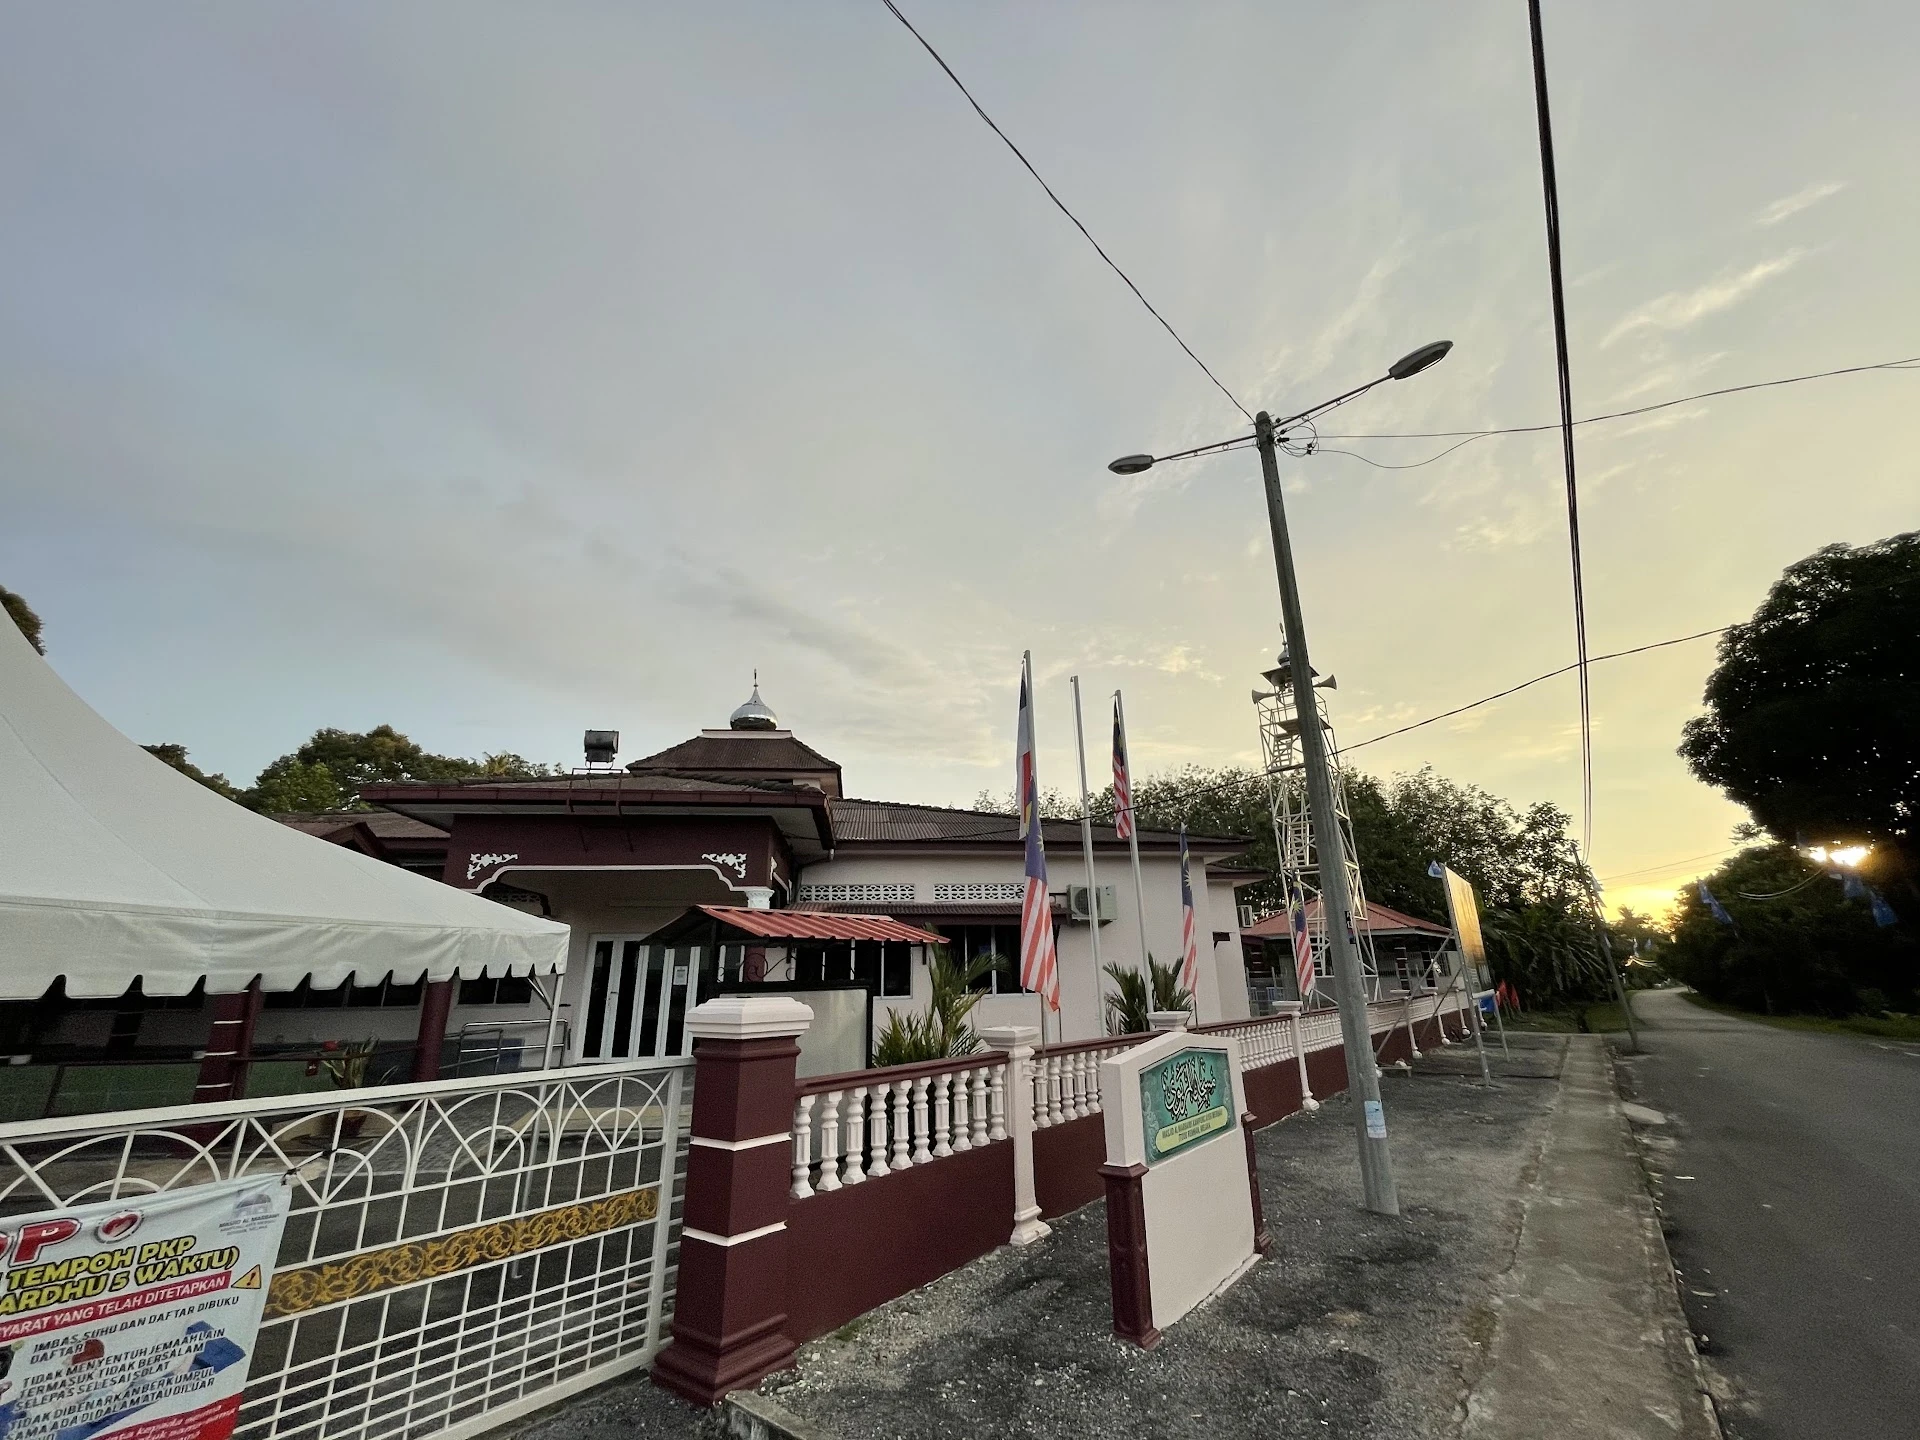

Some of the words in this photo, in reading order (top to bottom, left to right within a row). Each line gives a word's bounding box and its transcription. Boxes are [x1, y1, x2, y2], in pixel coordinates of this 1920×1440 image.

[0, 1217, 82, 1268] P
[6, 1246, 137, 1292] TEMPOH
[137, 1235, 197, 1265] PKP
[108, 1270, 131, 1292] 5
[134, 1245, 240, 1286] WAKTU)
[0, 1316, 51, 1338] YARAT
[53, 1306, 93, 1326] YANG
[98, 1294, 142, 1316] TELAH
[145, 1276, 226, 1303] DITETAPKAN
[83, 1324, 117, 1340] SUHU
[119, 1316, 146, 1331] DAN
[148, 1305, 195, 1324] DAFTAR
[20, 1371, 94, 1400] TERMASUK
[99, 1359, 136, 1379] TIDAK
[138, 1342, 204, 1367] BERSALAM
[23, 1369, 63, 1388] TIDAK
[66, 1347, 147, 1376] MENYENTUH
[149, 1333, 197, 1355] JEMAAH
[199, 1328, 225, 1341] LAIN
[30, 1343, 84, 1365] DAFTAR
[10, 1411, 51, 1431] TIDAK
[54, 1387, 141, 1419] DIBENARKAN
[141, 1366, 214, 1392] BERKUMPUL
[15, 1388, 75, 1411] SELEPAS
[77, 1371, 131, 1395] SELESAI
[132, 1361, 171, 1381] SOLAT
